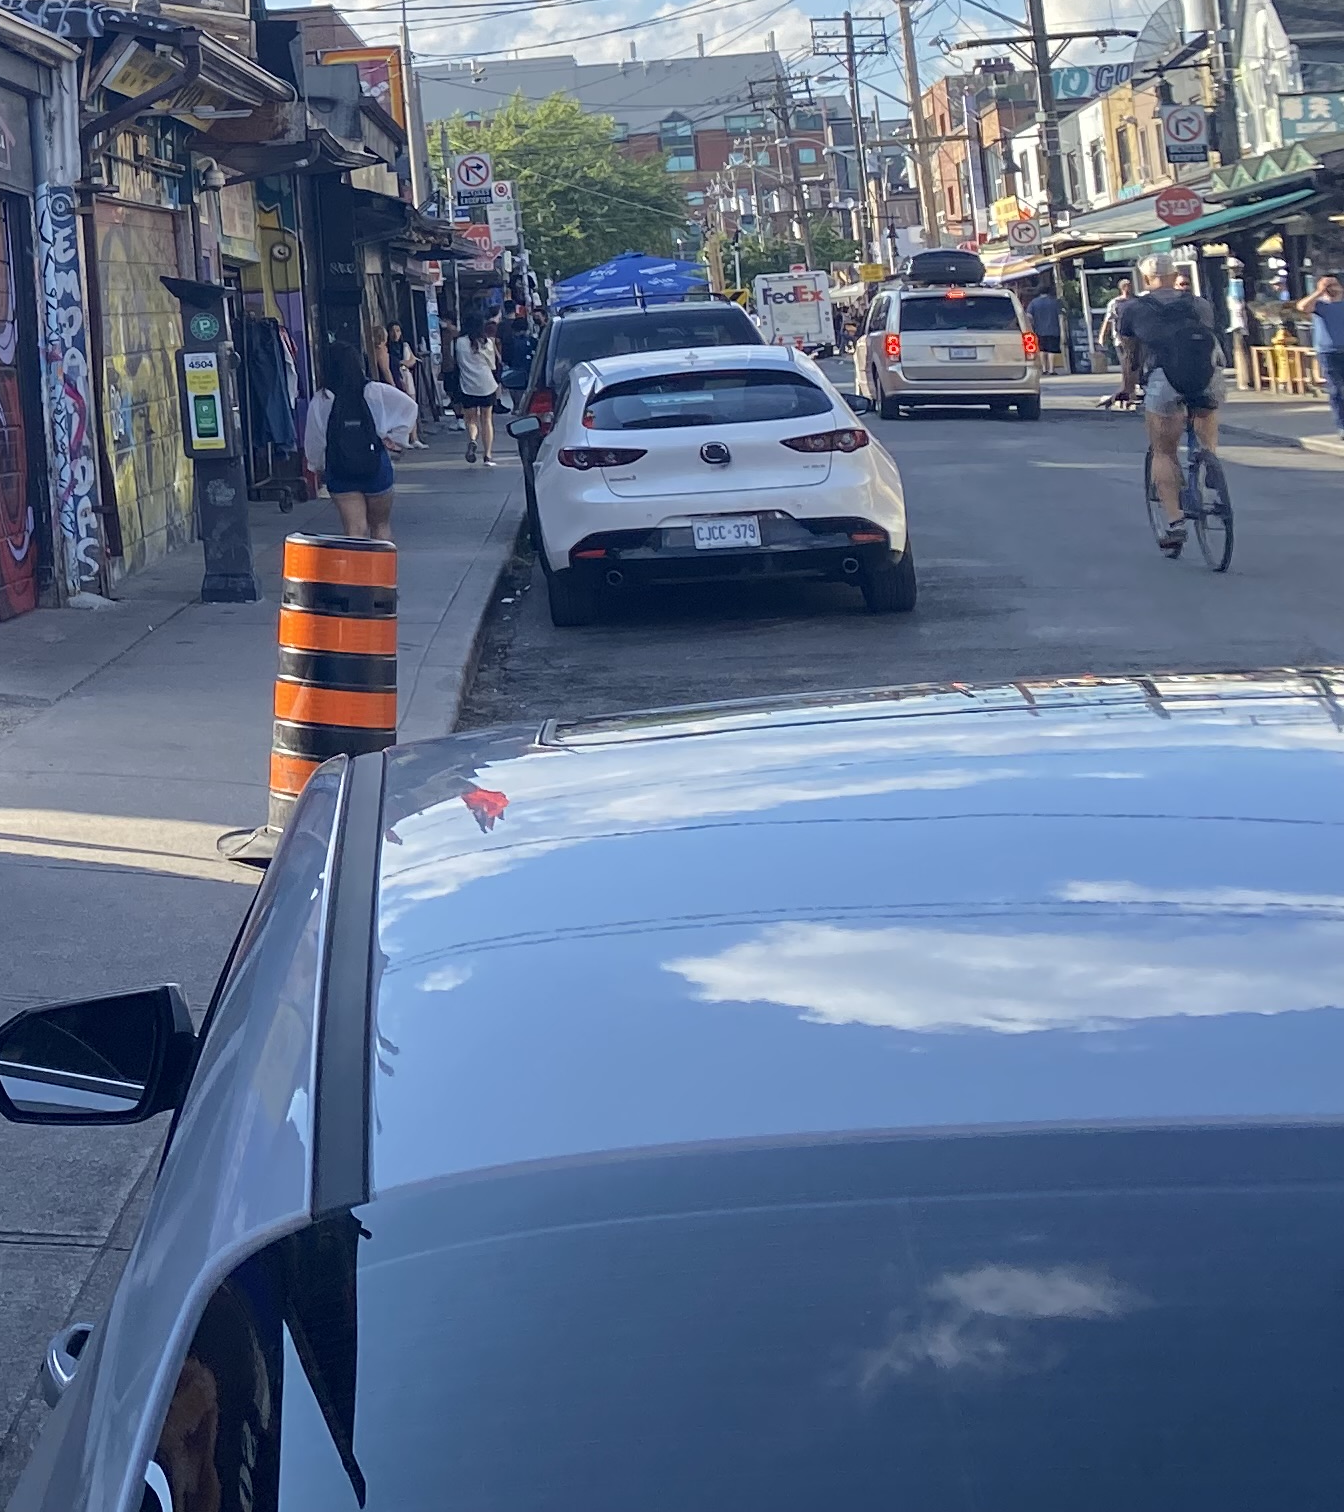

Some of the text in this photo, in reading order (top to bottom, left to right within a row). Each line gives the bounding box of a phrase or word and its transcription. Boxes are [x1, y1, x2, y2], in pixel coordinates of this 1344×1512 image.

[1159, 198, 1200, 216] STOP
[762, 284, 825, 306] FedEx
[188, 360, 214, 370] 4504
